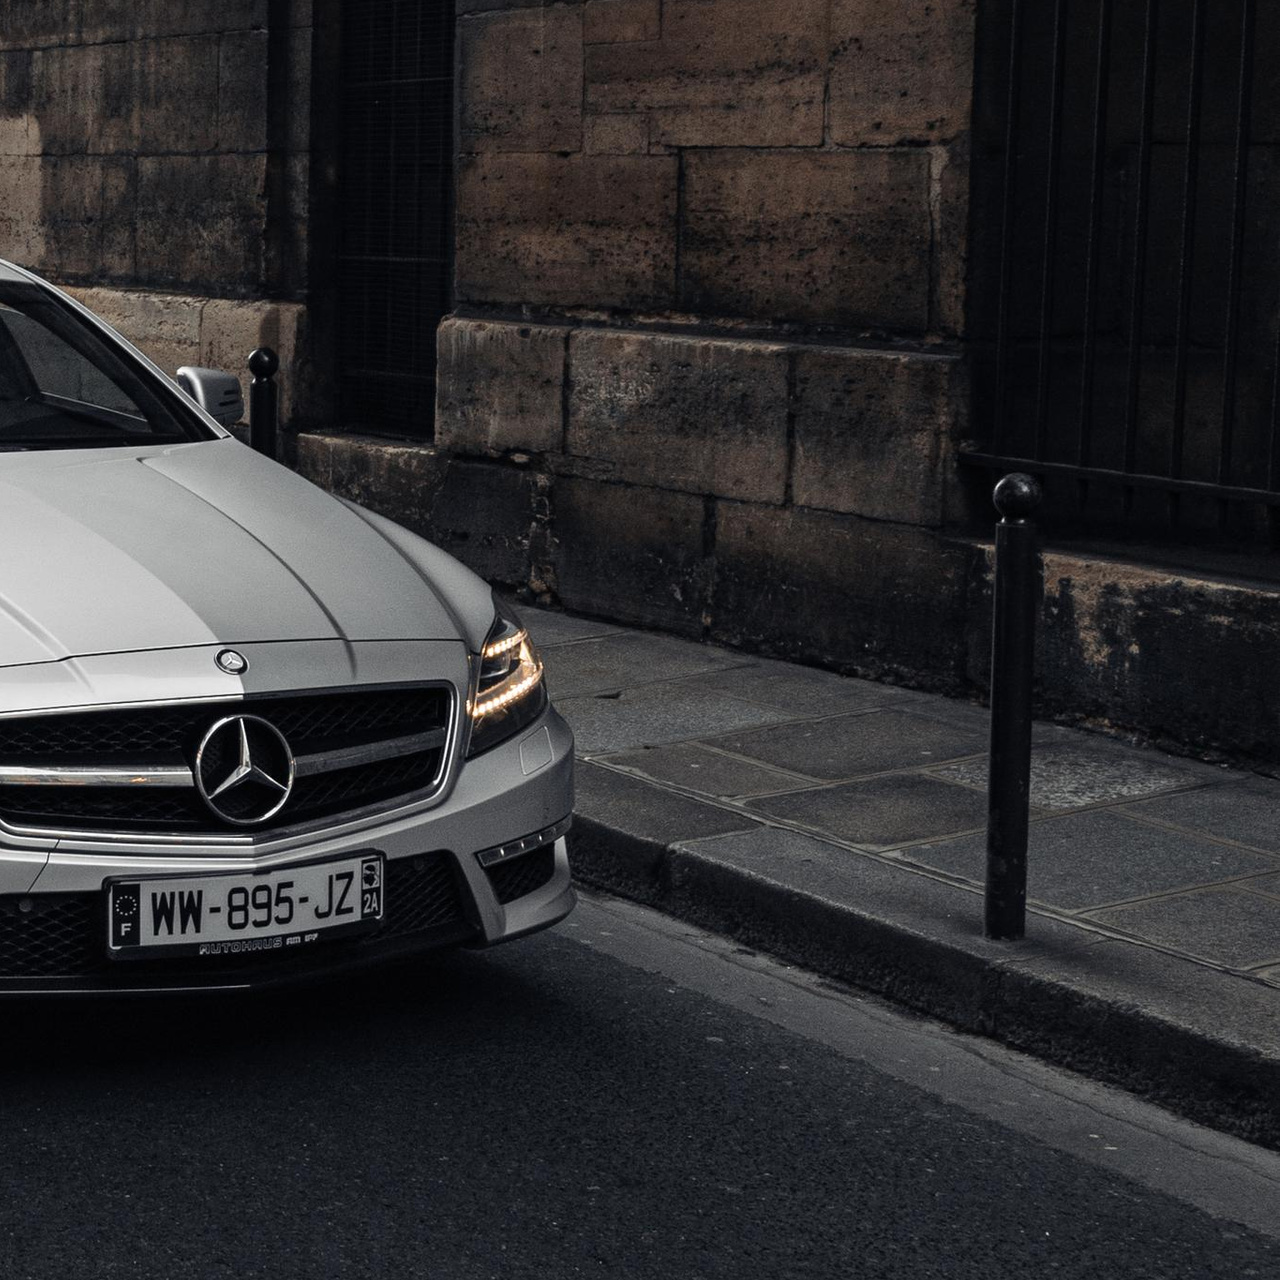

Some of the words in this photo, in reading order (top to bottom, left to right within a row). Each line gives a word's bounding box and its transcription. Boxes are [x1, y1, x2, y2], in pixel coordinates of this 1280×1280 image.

[151, 871, 355, 936] WW-895-JZ
[363, 891, 379, 913] 2A
[121, 923, 131, 936] F
[199, 937, 283, 955] AUTOHAUS
